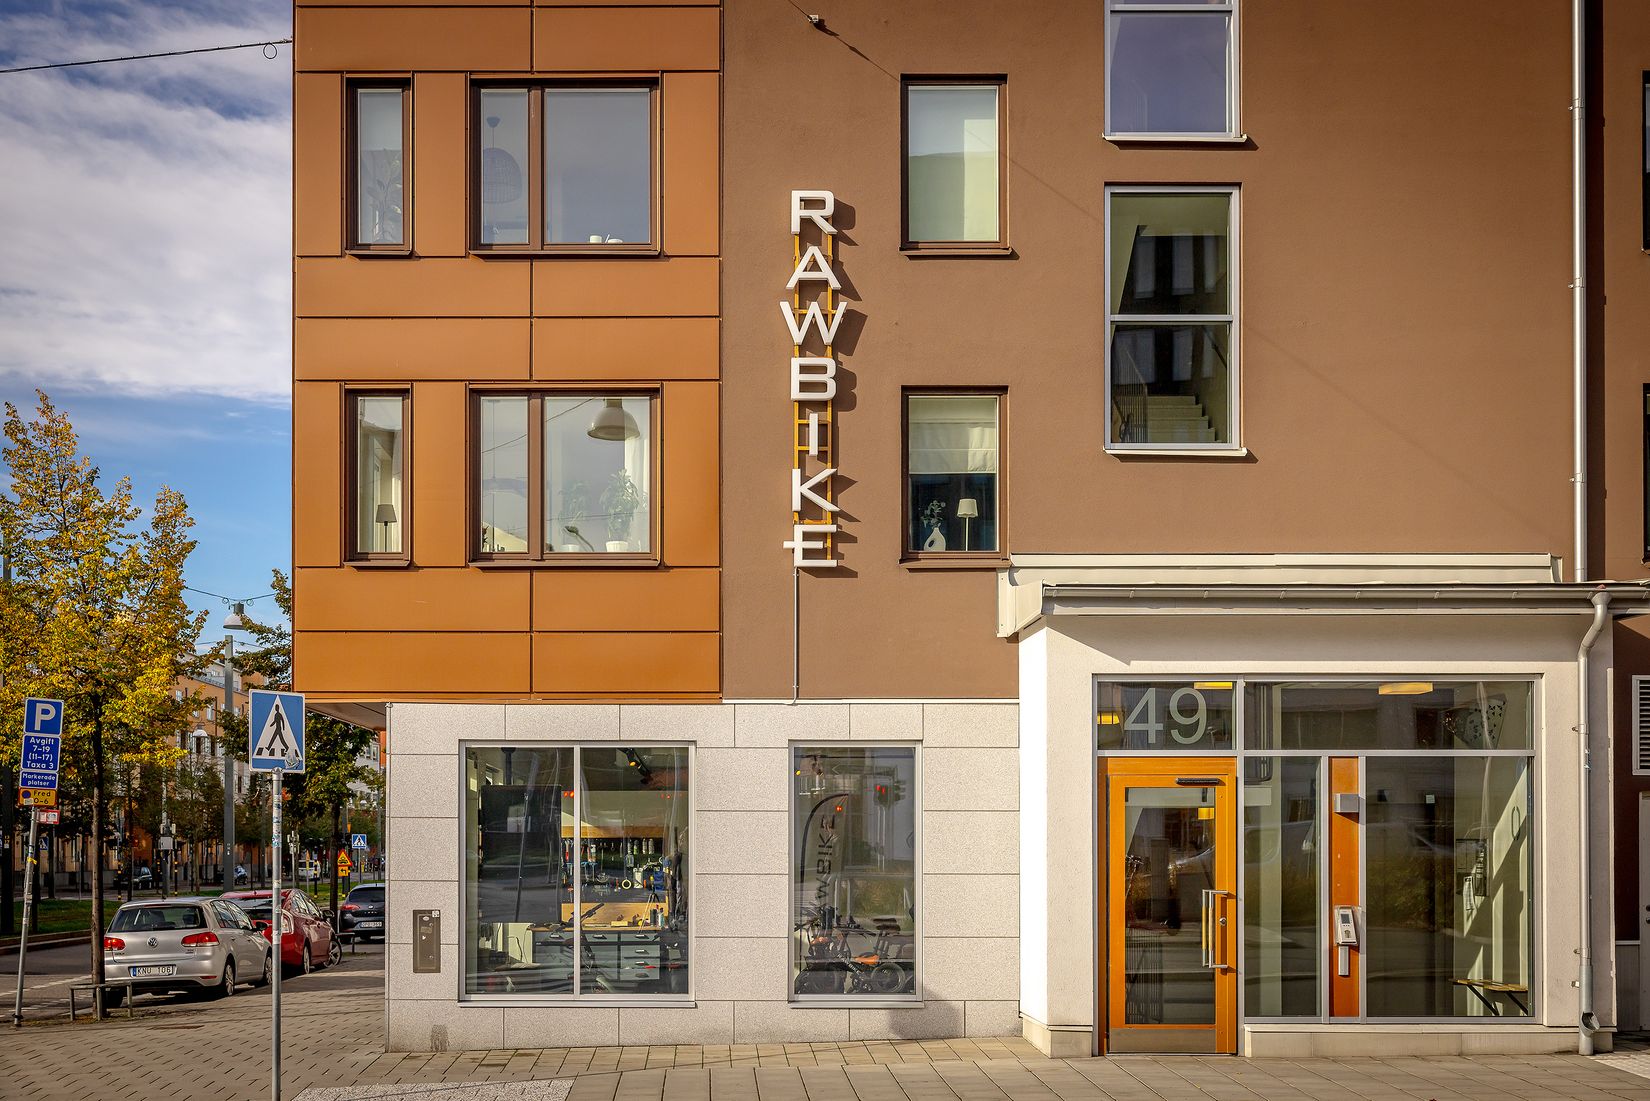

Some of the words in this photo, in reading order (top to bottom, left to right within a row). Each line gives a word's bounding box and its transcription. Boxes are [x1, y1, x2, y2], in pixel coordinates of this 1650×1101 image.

[779, 190, 848, 568] RAWBIKE
[34, 702, 56, 731] P
[1124, 687, 1208, 744] 49
[29, 736, 55, 746] Avgift
[32, 745, 51, 753] 7-19
[26, 760, 46, 769] Taxa
[22, 773, 56, 781] Markerade
[137, 967, 152, 975] KNU
